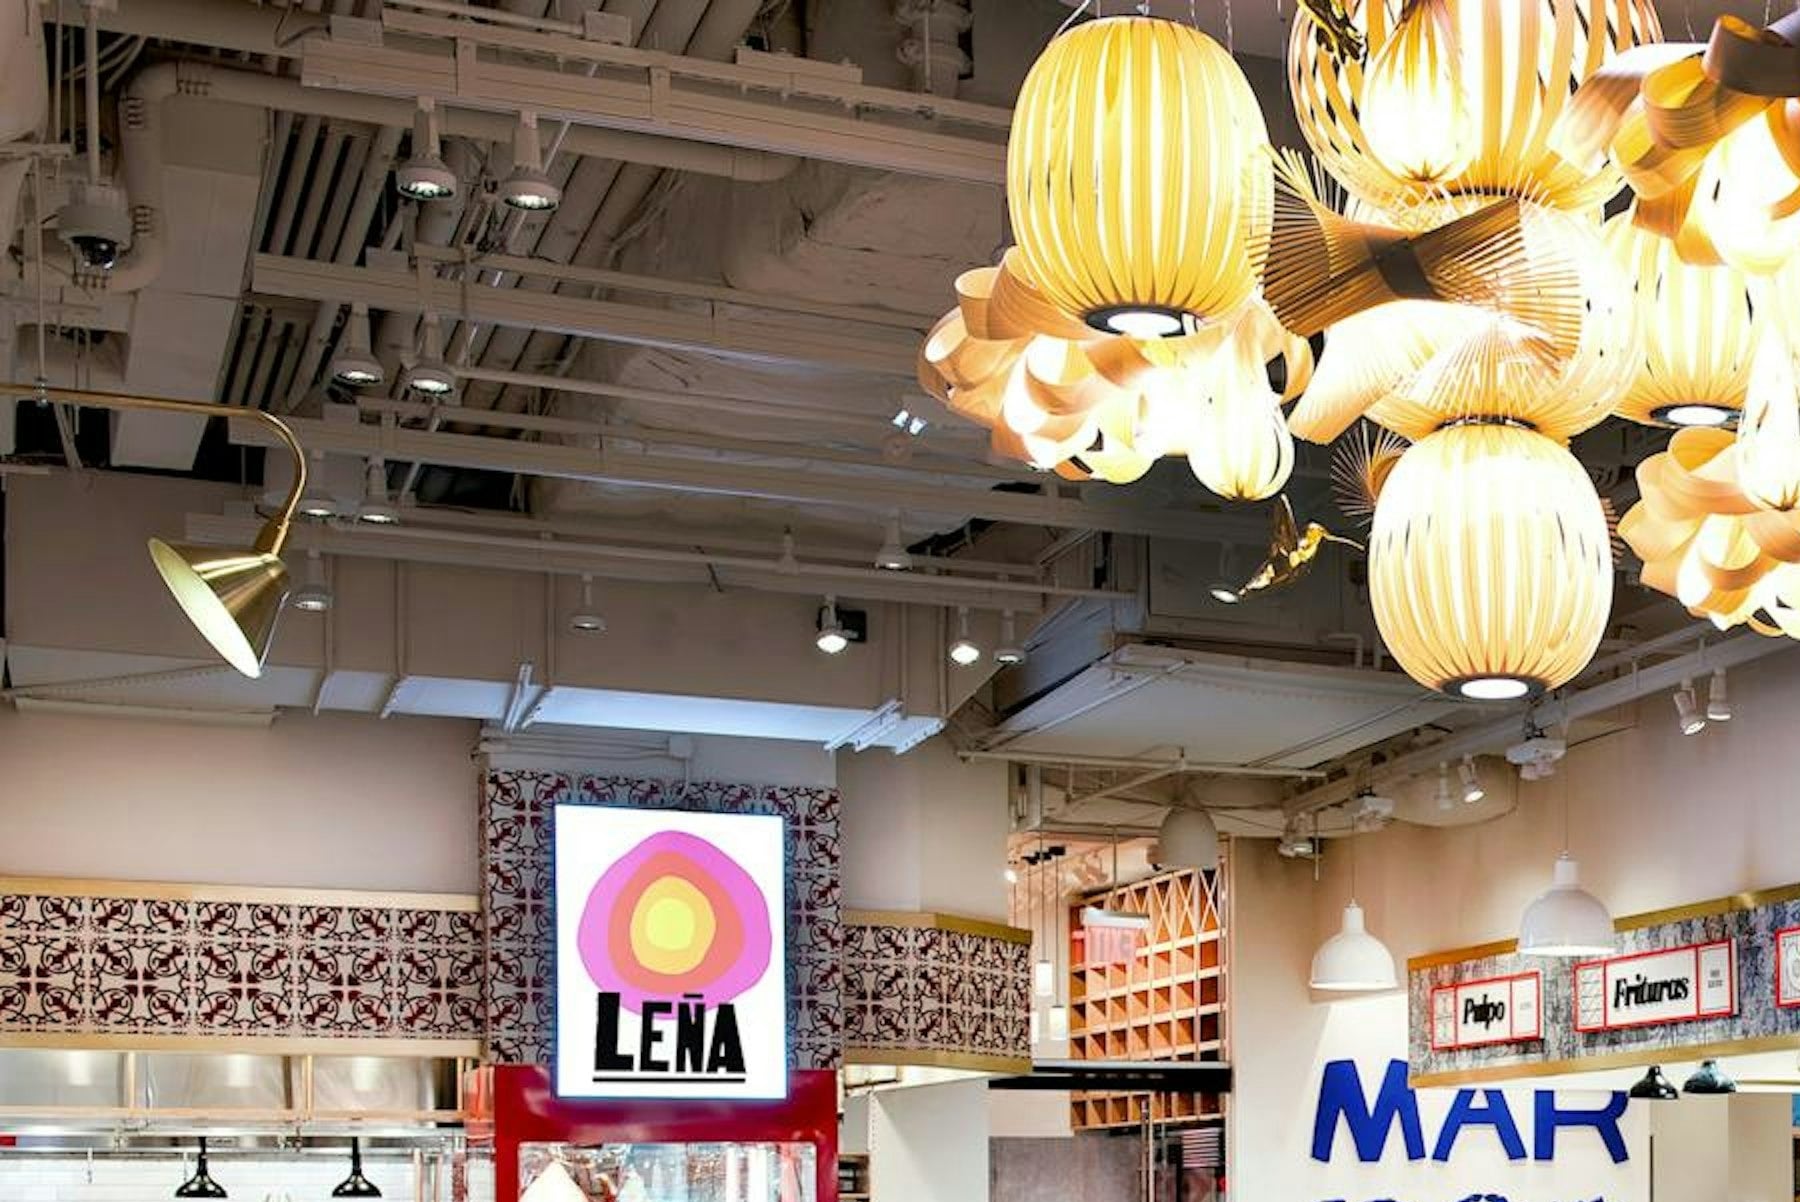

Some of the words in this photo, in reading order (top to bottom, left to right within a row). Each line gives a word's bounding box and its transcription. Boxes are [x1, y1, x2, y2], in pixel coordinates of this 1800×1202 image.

[1463, 993, 1505, 1030] Pulpo
[1614, 973, 1689, 1008] Frituras
[594, 992, 746, 1073] LEÑA
[1311, 1058, 1630, 1164] MAR
